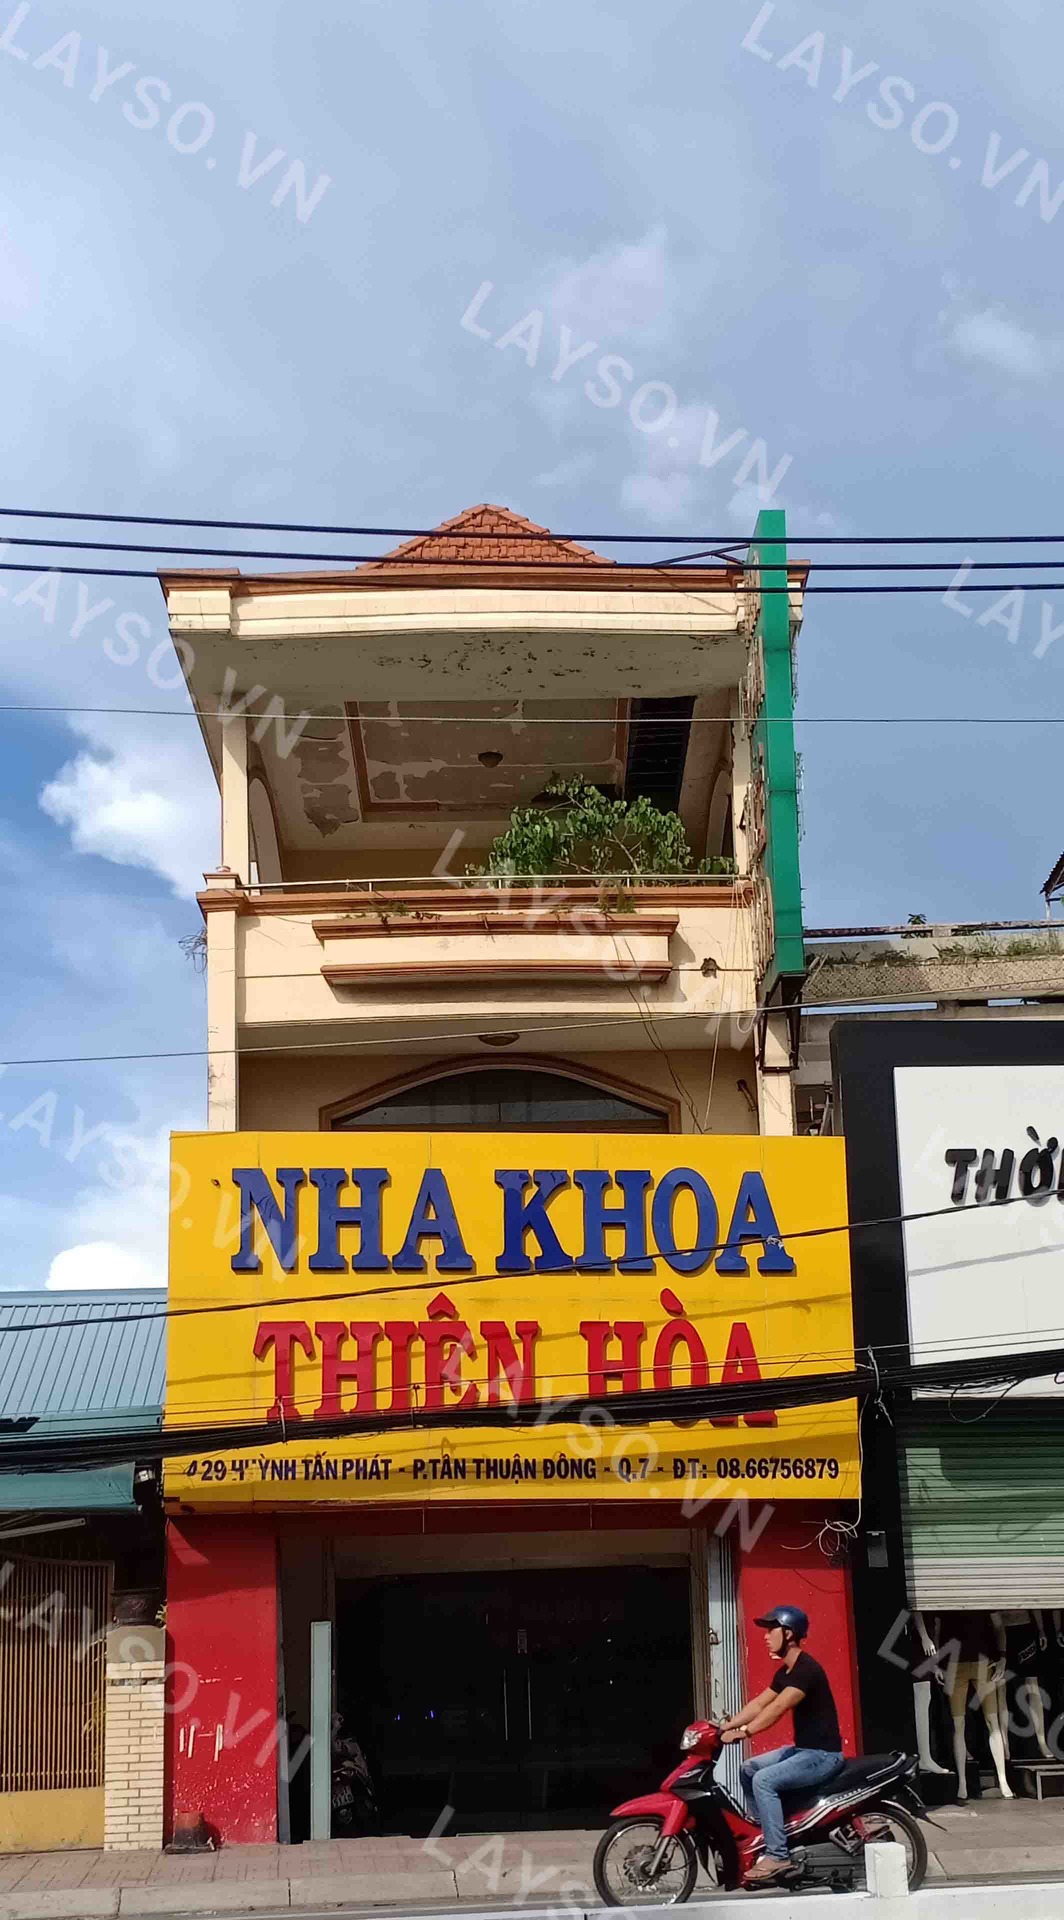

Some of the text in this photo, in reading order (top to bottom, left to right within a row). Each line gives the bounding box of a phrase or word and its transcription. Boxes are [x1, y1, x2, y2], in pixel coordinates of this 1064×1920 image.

[231, 1168, 474, 1273] NHA
[494, 1167, 796, 1275] KHOA
[253, 1288, 778, 1426] THIÊN HÒA
[342, 1453, 392, 1480] PHÁT
[473, 1454, 537, 1484] THUẬN
[543, 1453, 597, 1480] ĐÔNG
[618, 1457, 650, 1483] Q.7
[673, 1457, 707, 1479] ĐT:
[716, 1457, 840, 1480] 08.66756879
